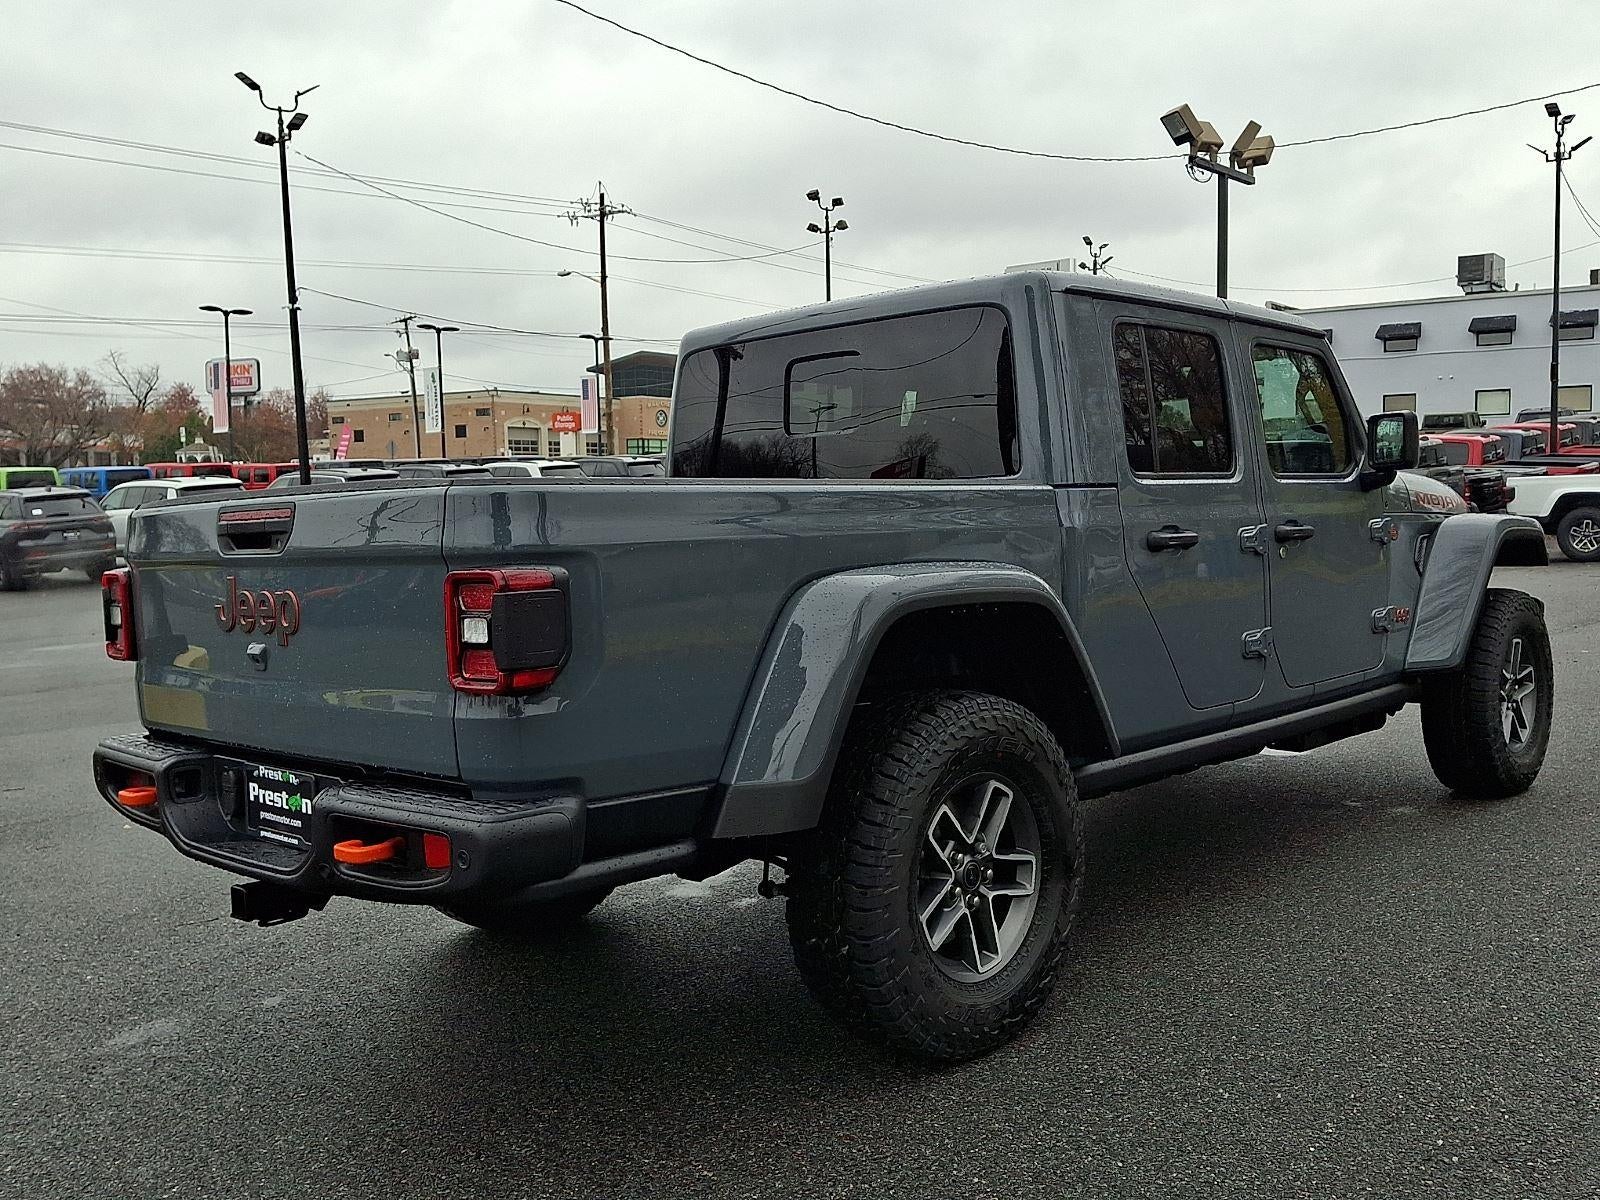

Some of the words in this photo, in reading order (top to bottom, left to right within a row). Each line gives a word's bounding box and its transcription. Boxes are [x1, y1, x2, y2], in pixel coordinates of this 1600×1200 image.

[554, 421, 576, 429] Storage
[556, 414, 574, 422] Public
[215, 576, 299, 647] Jeep
[259, 765, 296, 783] Preston
[248, 782, 312, 815] Preston
[260, 811, 302, 828] prestonmotor.com
